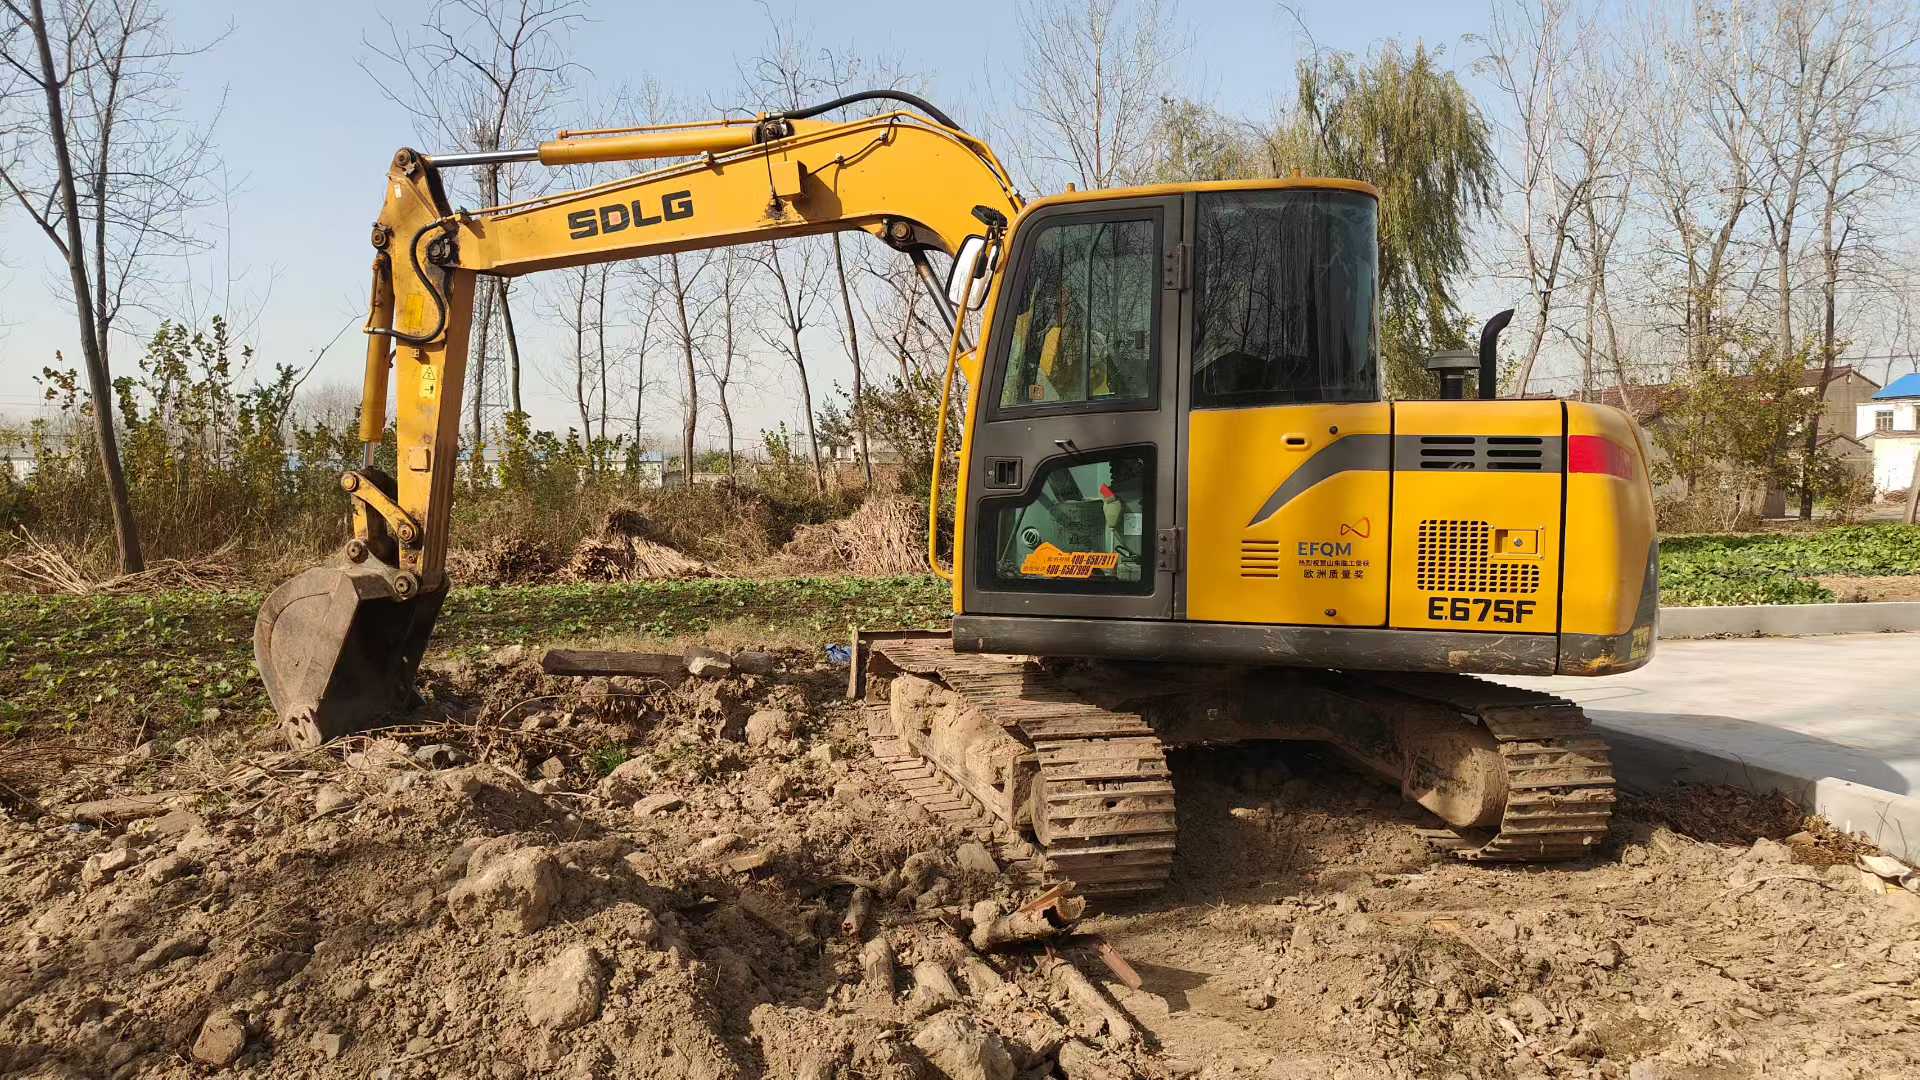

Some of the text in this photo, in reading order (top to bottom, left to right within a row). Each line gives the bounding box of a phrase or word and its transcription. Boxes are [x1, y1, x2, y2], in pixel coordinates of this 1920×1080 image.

[568, 190, 694, 240] SDLG
[1297, 541, 1352, 558] EFQM
[1303, 568, 1365, 580] 欧洲质量奖
[1428, 596, 1537, 624] E675F
